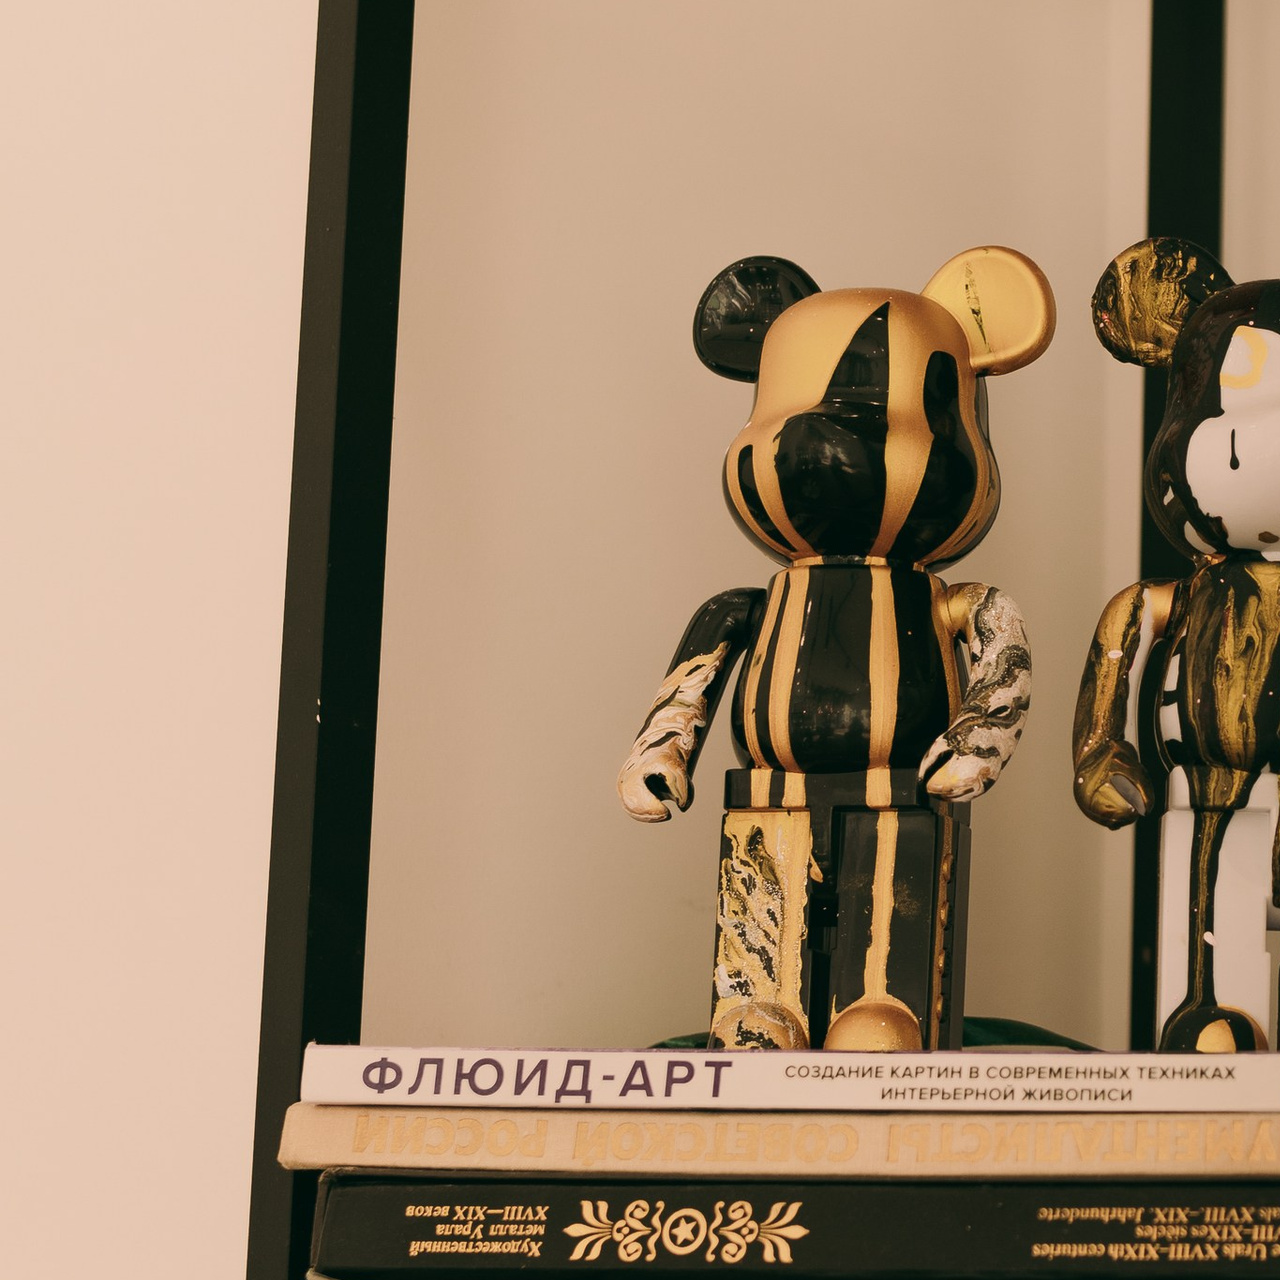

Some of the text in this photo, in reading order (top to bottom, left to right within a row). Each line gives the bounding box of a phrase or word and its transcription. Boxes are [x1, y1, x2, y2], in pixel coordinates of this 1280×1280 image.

[361, 1056, 734, 1104] ФЛЮИД-АРТ
[784, 1065, 1237, 1081] СОЗДАНИЕ КАРТИН В СОВРЕМЕННЫХ ТЕХНИКАХ
[880, 1084, 1134, 1102] ИНТЕРЬЕРНОЙ ЖИВОПИСИ
[352, 1115, 548, 1157] РОССИИ
[573, 1122, 859, 1167] СОВЕТСКОЙ
[405, 1205, 450, 1218] веков
[1037, 1207, 1145, 1224] Jahrhunderte
[436, 1221, 545, 1239] металл Урала
[1135, 1225, 1187, 1242] siècles
[409, 1238, 543, 1257] Художественный
[1031, 1243, 1105, 1261] centuries
[1222, 1243, 1266, 1261] Urals
